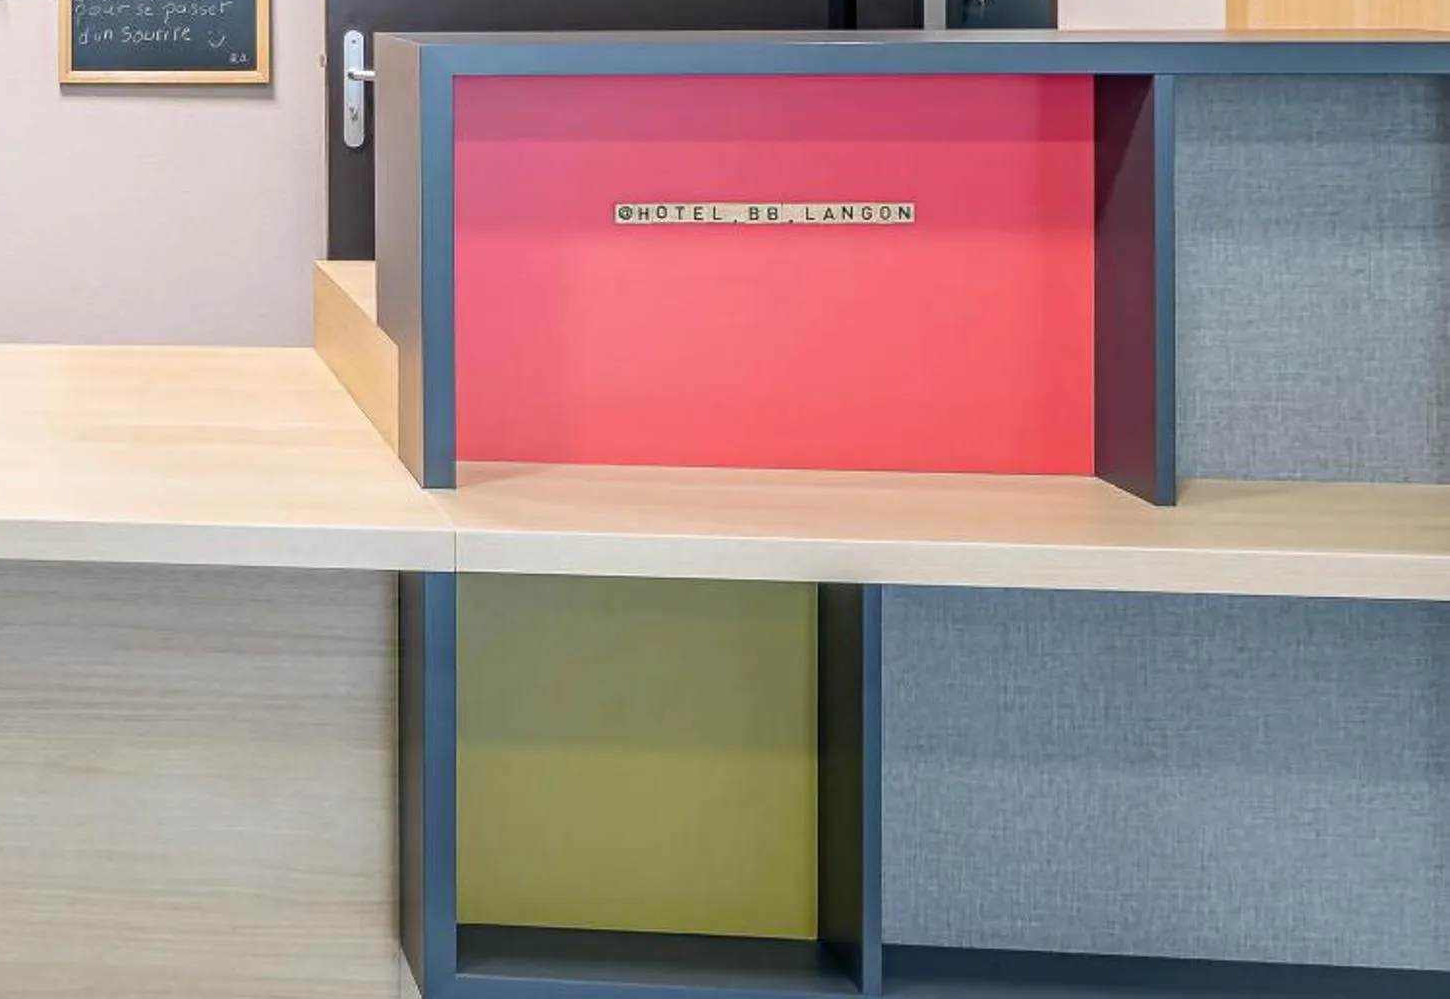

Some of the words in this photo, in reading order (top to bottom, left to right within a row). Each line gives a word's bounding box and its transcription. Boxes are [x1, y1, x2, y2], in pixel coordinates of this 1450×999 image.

[75, 3, 131, 27] pour
[135, 3, 155, 16] se
[162, 0, 234, 24] passer
